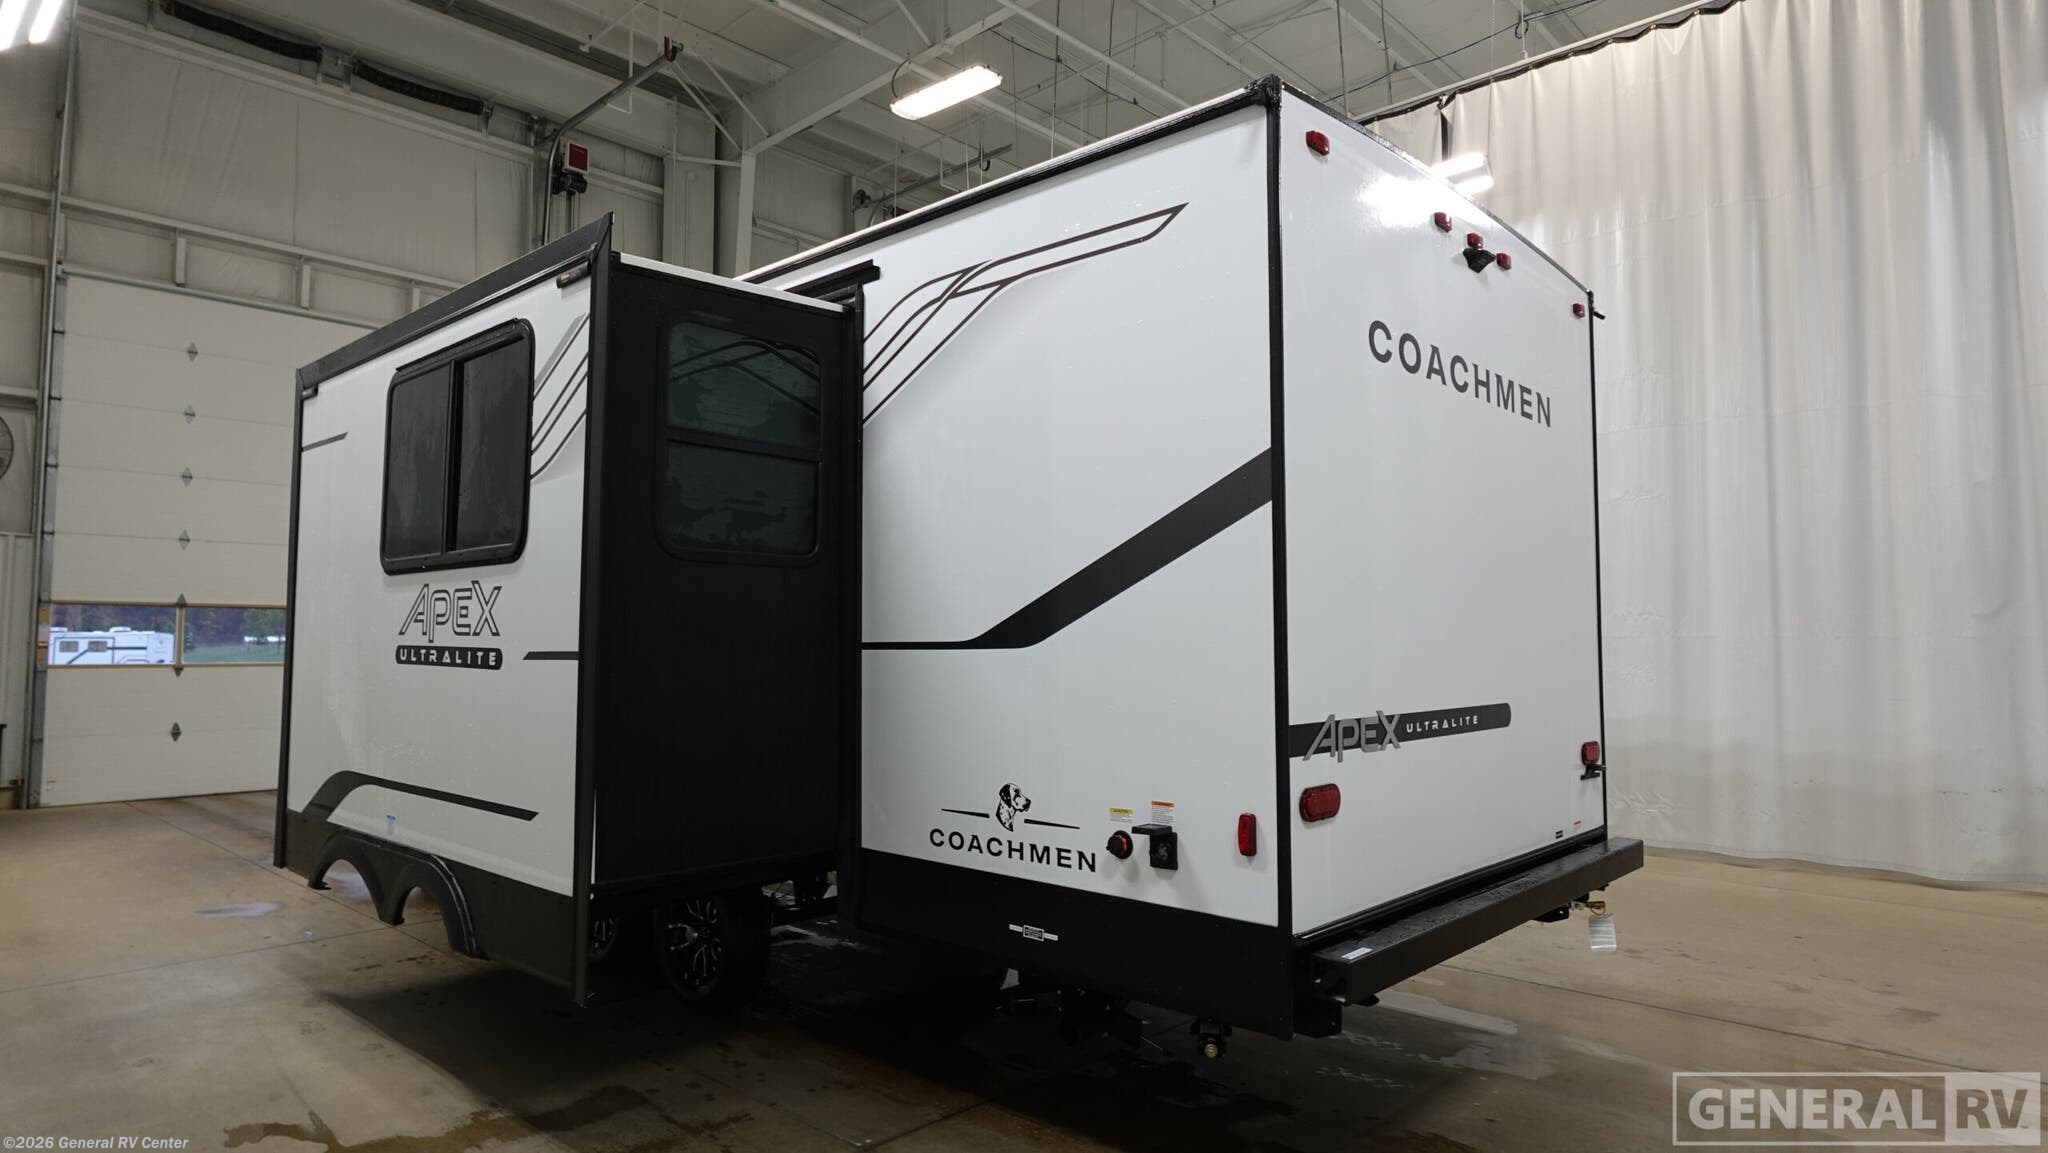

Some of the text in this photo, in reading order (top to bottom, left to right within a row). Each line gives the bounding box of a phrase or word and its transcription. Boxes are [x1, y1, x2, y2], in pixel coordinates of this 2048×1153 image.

[1368, 320, 1552, 428] COACHMEN
[398, 580, 502, 643] APEX
[400, 648, 497, 666] ULTRALITE
[1302, 710, 1479, 762] APEX ULTRALITE
[929, 828, 1097, 873] COACHMEN
